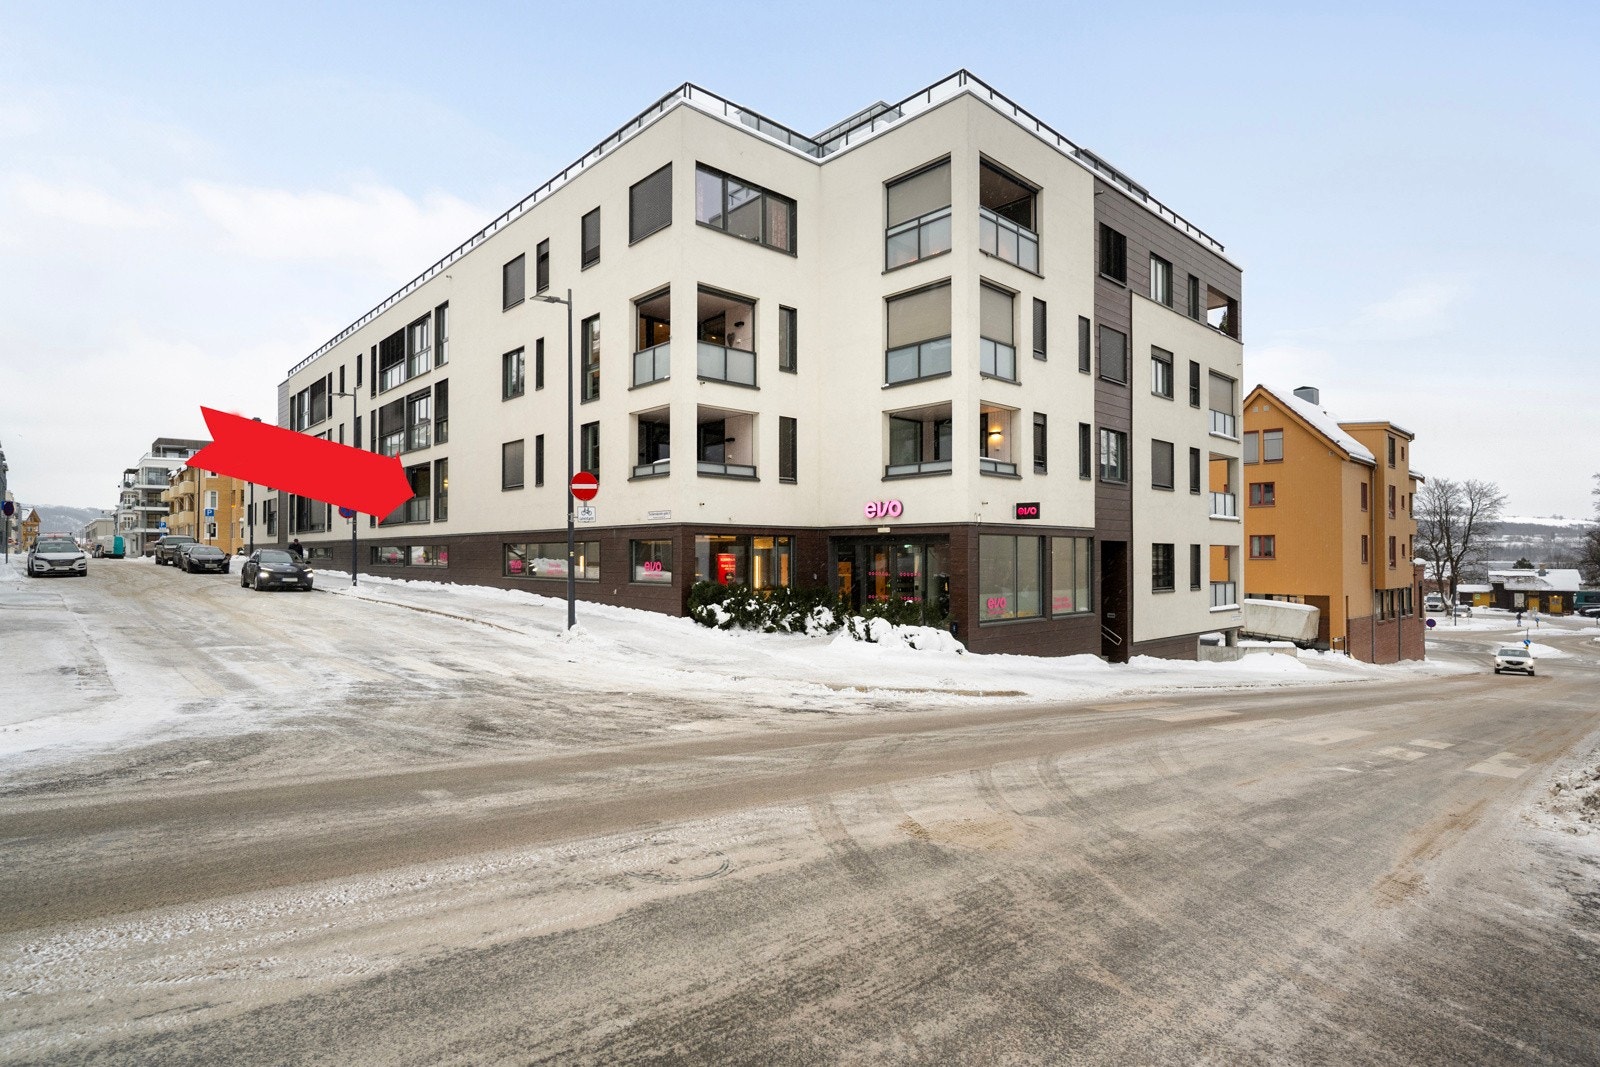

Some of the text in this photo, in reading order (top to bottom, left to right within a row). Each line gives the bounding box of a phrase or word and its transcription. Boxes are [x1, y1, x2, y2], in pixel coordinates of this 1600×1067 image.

[864, 500, 903, 519] evo
[1017, 506, 1037, 515] evo
[644, 561, 662, 571] evo
[987, 597, 1006, 609] evo
